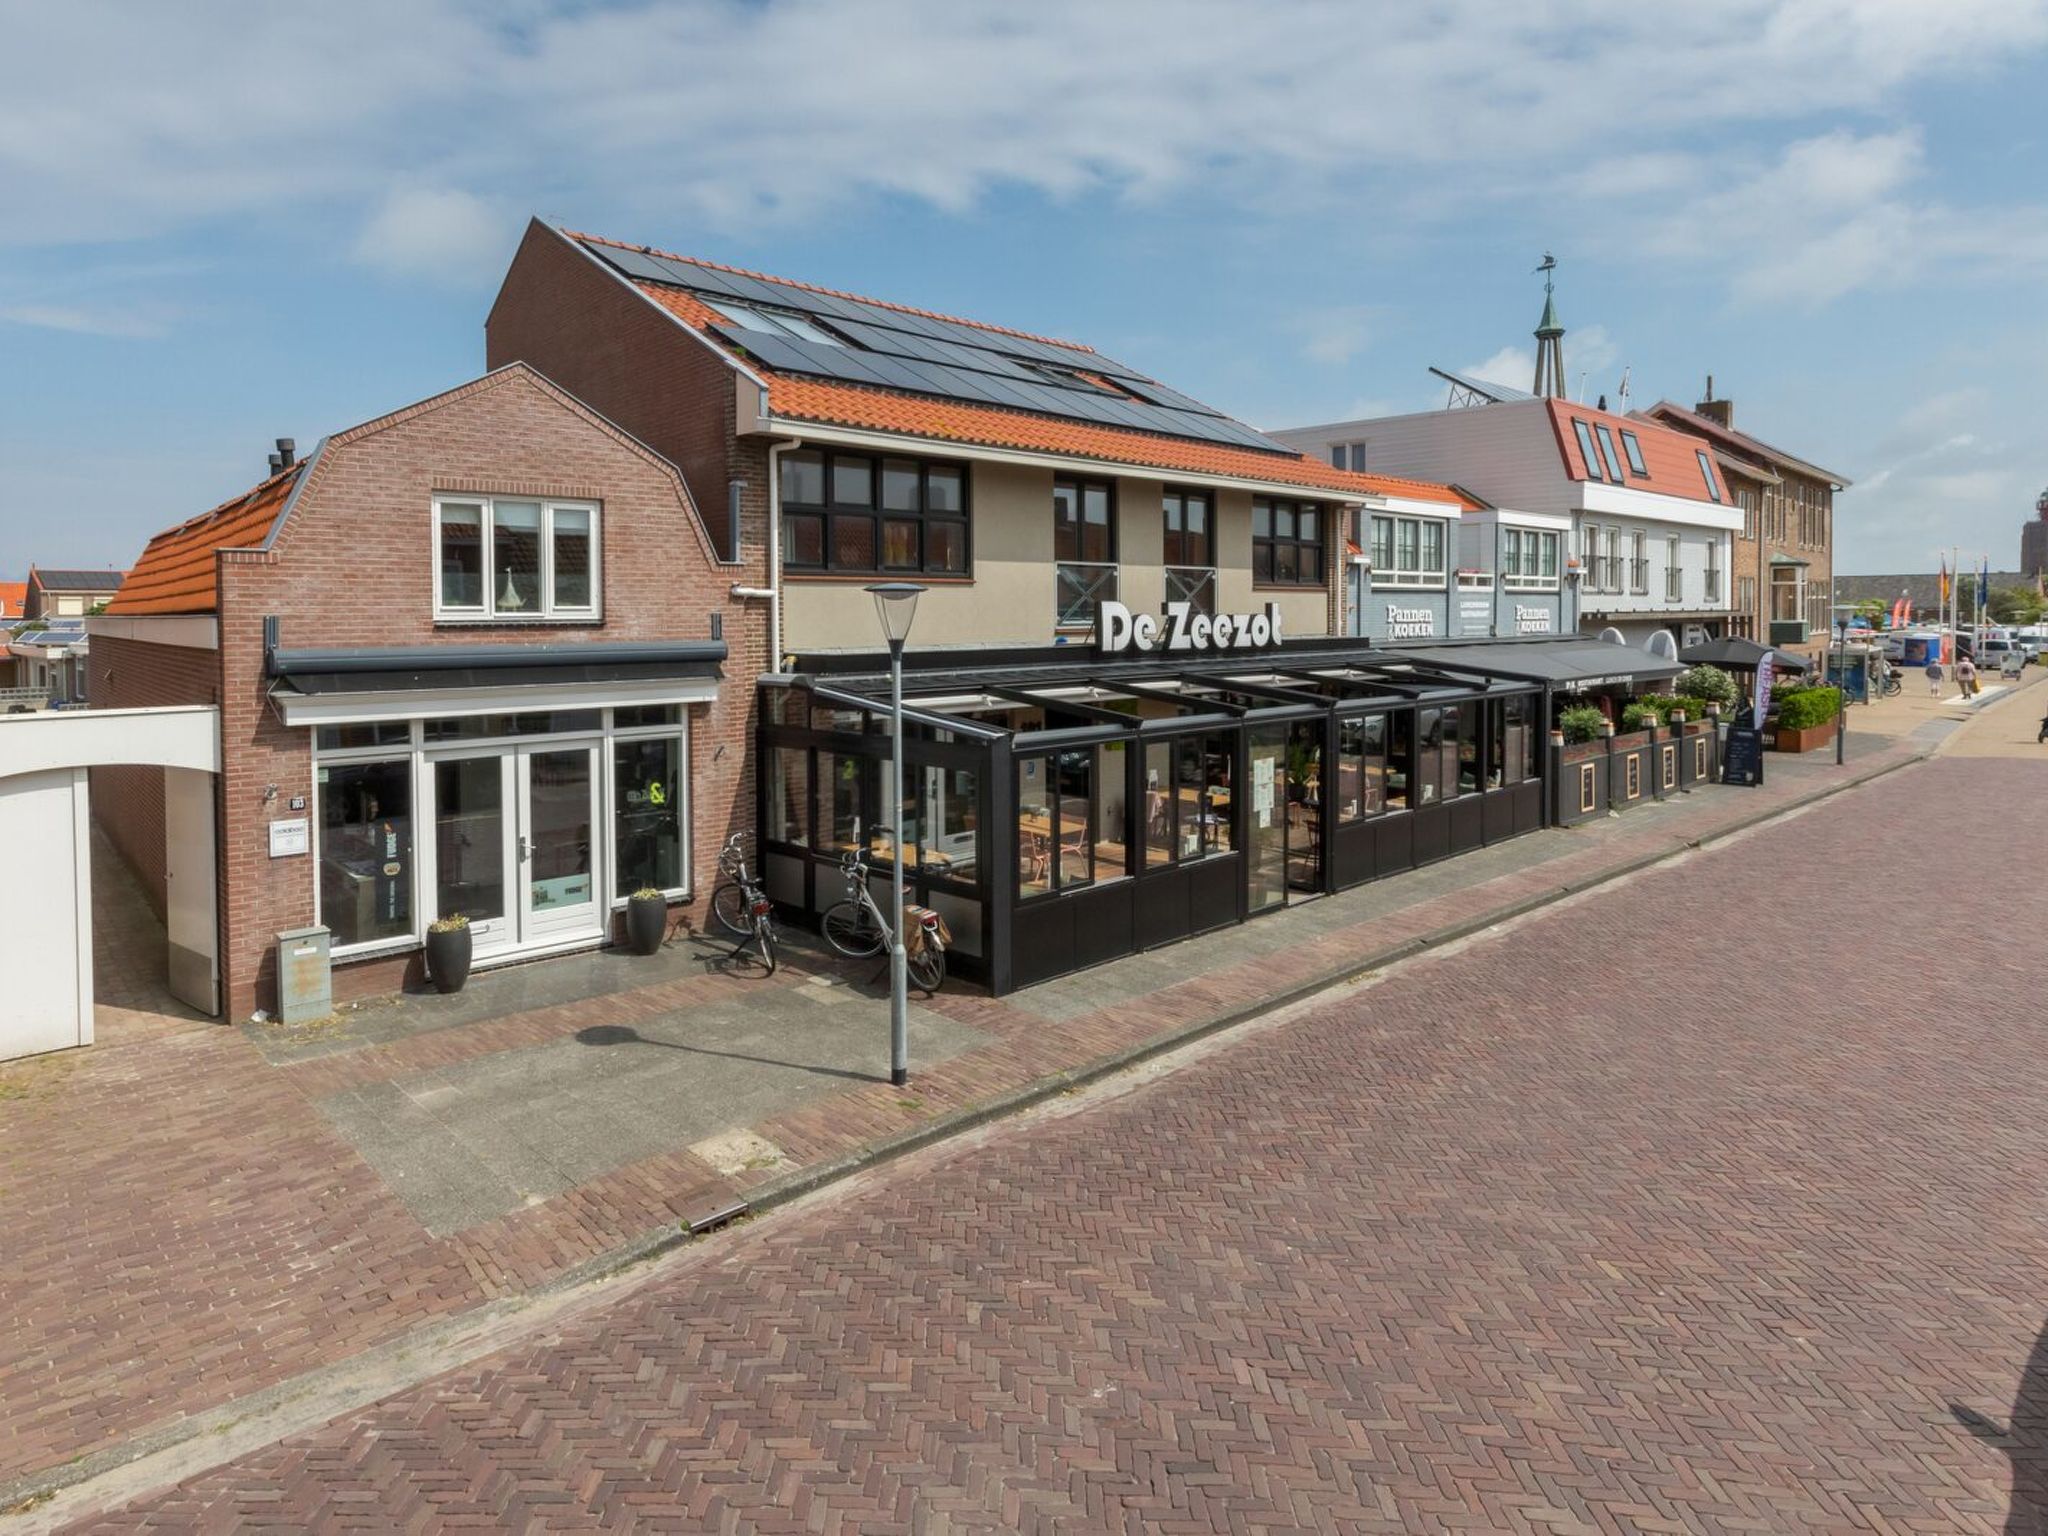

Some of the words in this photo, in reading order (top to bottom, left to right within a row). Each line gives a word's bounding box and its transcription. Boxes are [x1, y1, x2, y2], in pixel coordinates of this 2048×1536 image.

[1387, 605, 1433, 622] Pannen
[1516, 604, 1550, 620] Pannen
[1101, 601, 1157, 651] De
[1166, 601, 1282, 650] Zeezot
